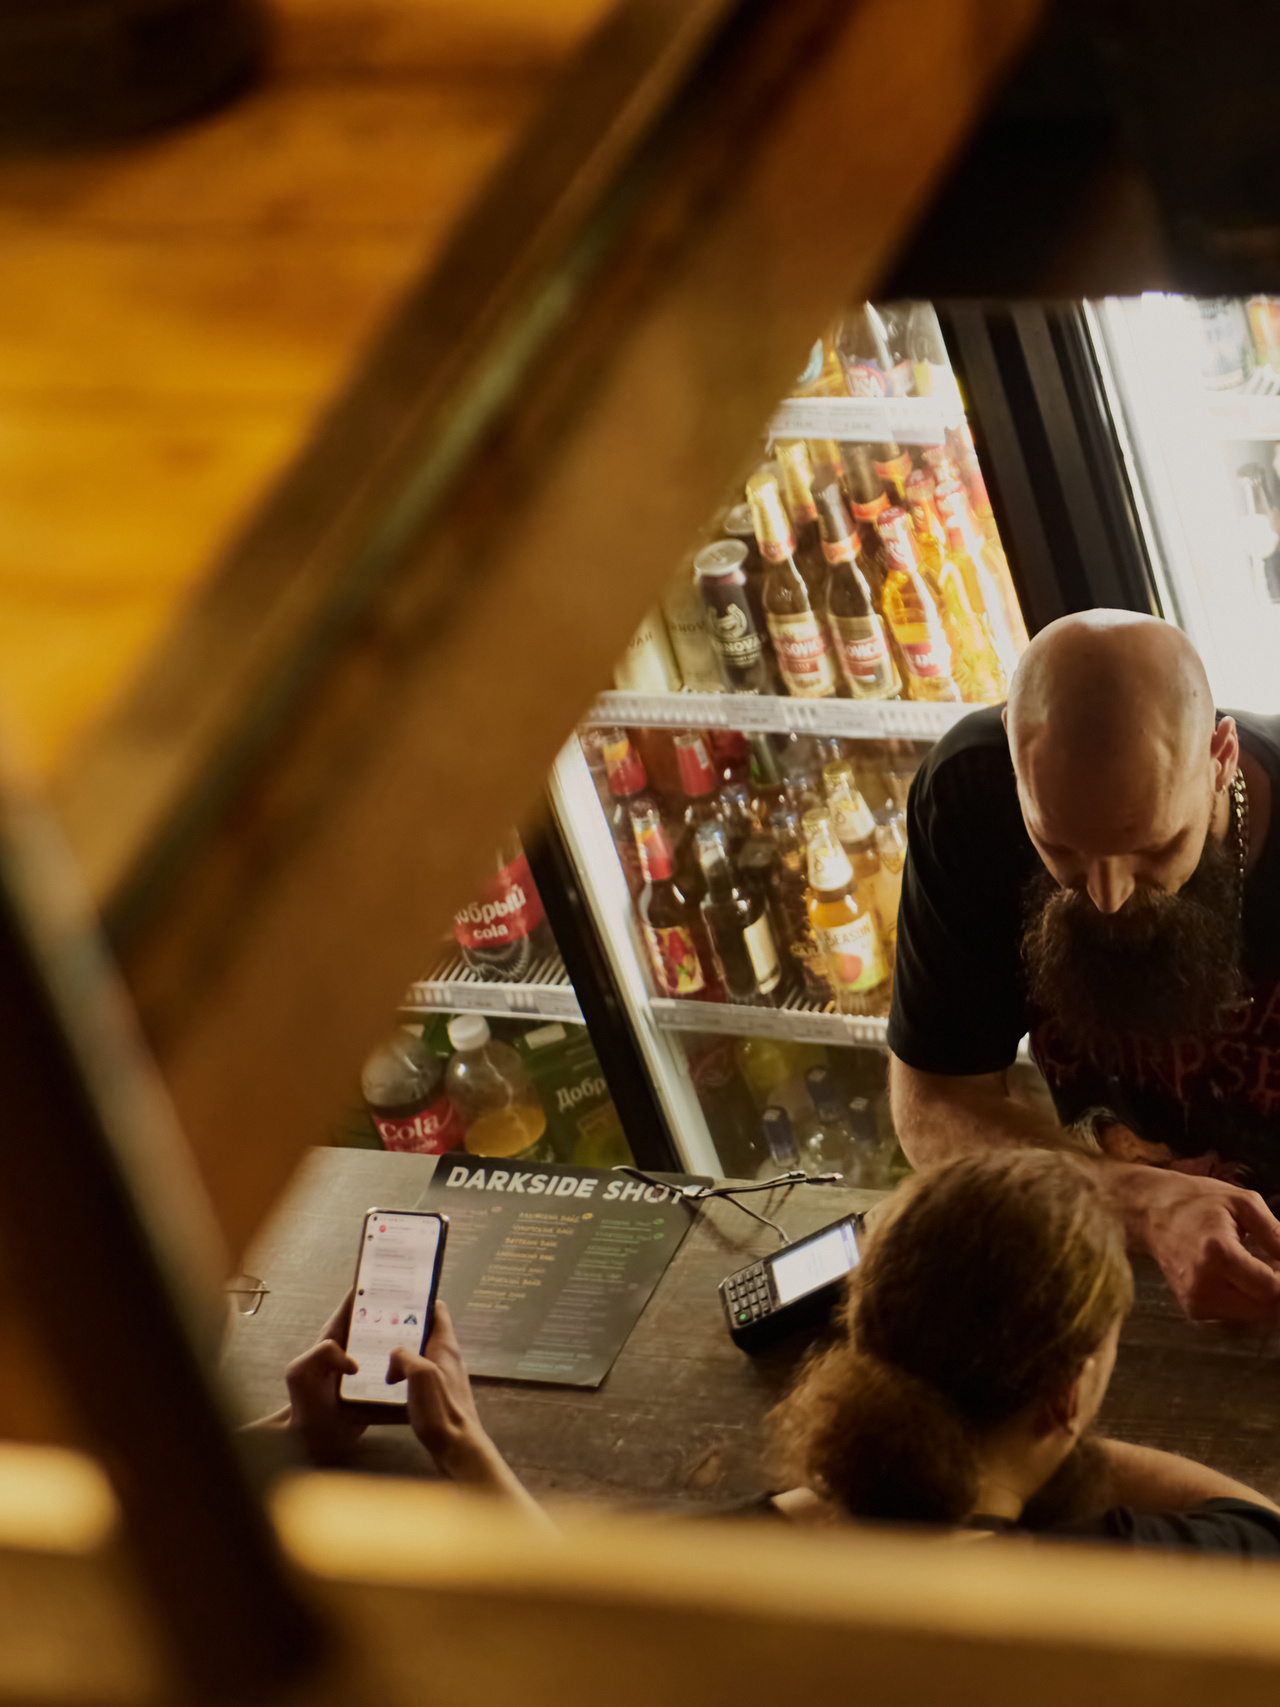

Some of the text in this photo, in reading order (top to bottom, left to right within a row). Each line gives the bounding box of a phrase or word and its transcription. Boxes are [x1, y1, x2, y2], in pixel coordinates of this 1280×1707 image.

[455, 884, 527, 924] обрый
[473, 922, 509, 939] cola
[379, 1114, 439, 1140] Cola
[445, 1166, 599, 1199] DARKSIDE
